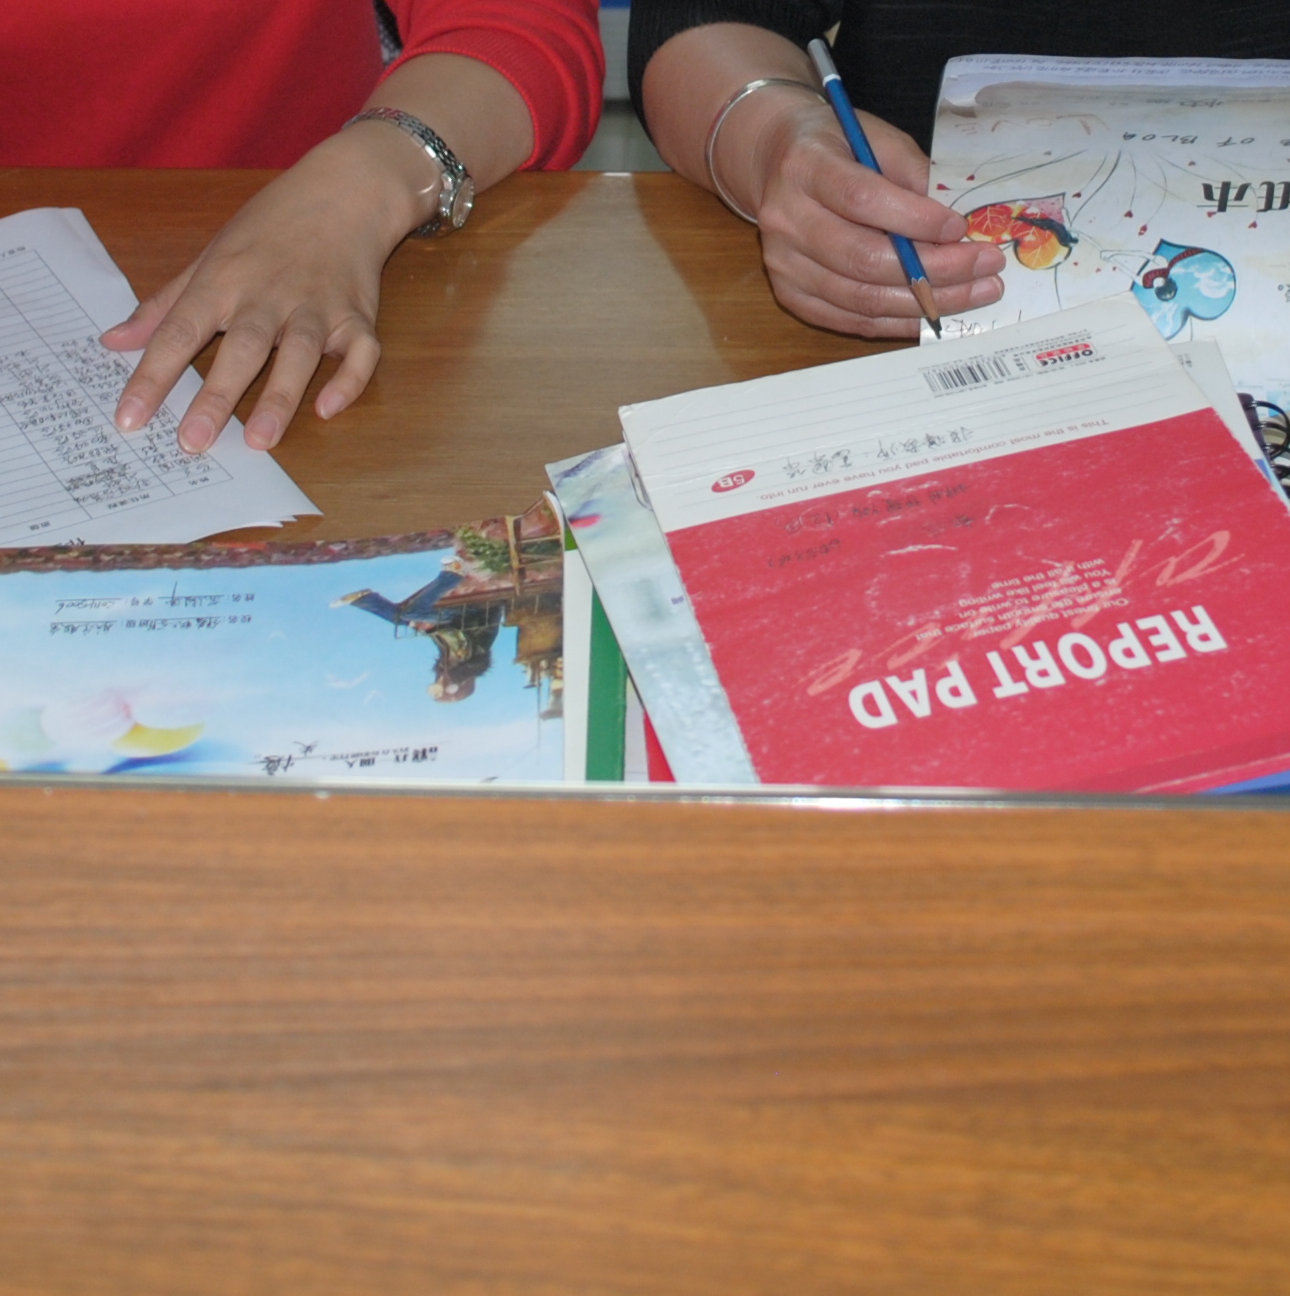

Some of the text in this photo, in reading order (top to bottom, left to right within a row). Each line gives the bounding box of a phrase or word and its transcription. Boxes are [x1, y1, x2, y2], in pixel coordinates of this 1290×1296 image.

[1040, 349, 1094, 367] OFFICE
[1081, 419, 1109, 429] This
[1009, 432, 1042, 445] most
[1044, 428, 1065, 437] the
[932, 440, 1007, 464] comfortable
[878, 463, 902, 477] you
[905, 457, 929, 470] pad
[717, 474, 746, 489] 5B
[844, 471, 876, 482] have
[786, 485, 809, 495] run
[812, 478, 843, 489] ever
[1077, 558, 1105, 570] with
[1023, 572, 1045, 583] the
[1084, 569, 1111, 578] You
[991, 578, 1021, 589] time
[1006, 586, 1030, 597] like
[958, 592, 1004, 608] writing
[1103, 597, 1129, 609] Our
[944, 615, 995, 634] surface
[1015, 611, 1059, 629] quality
[916, 628, 942, 641] that
[973, 620, 1012, 637] paper
[847, 605, 1228, 729] REPORT PAD
